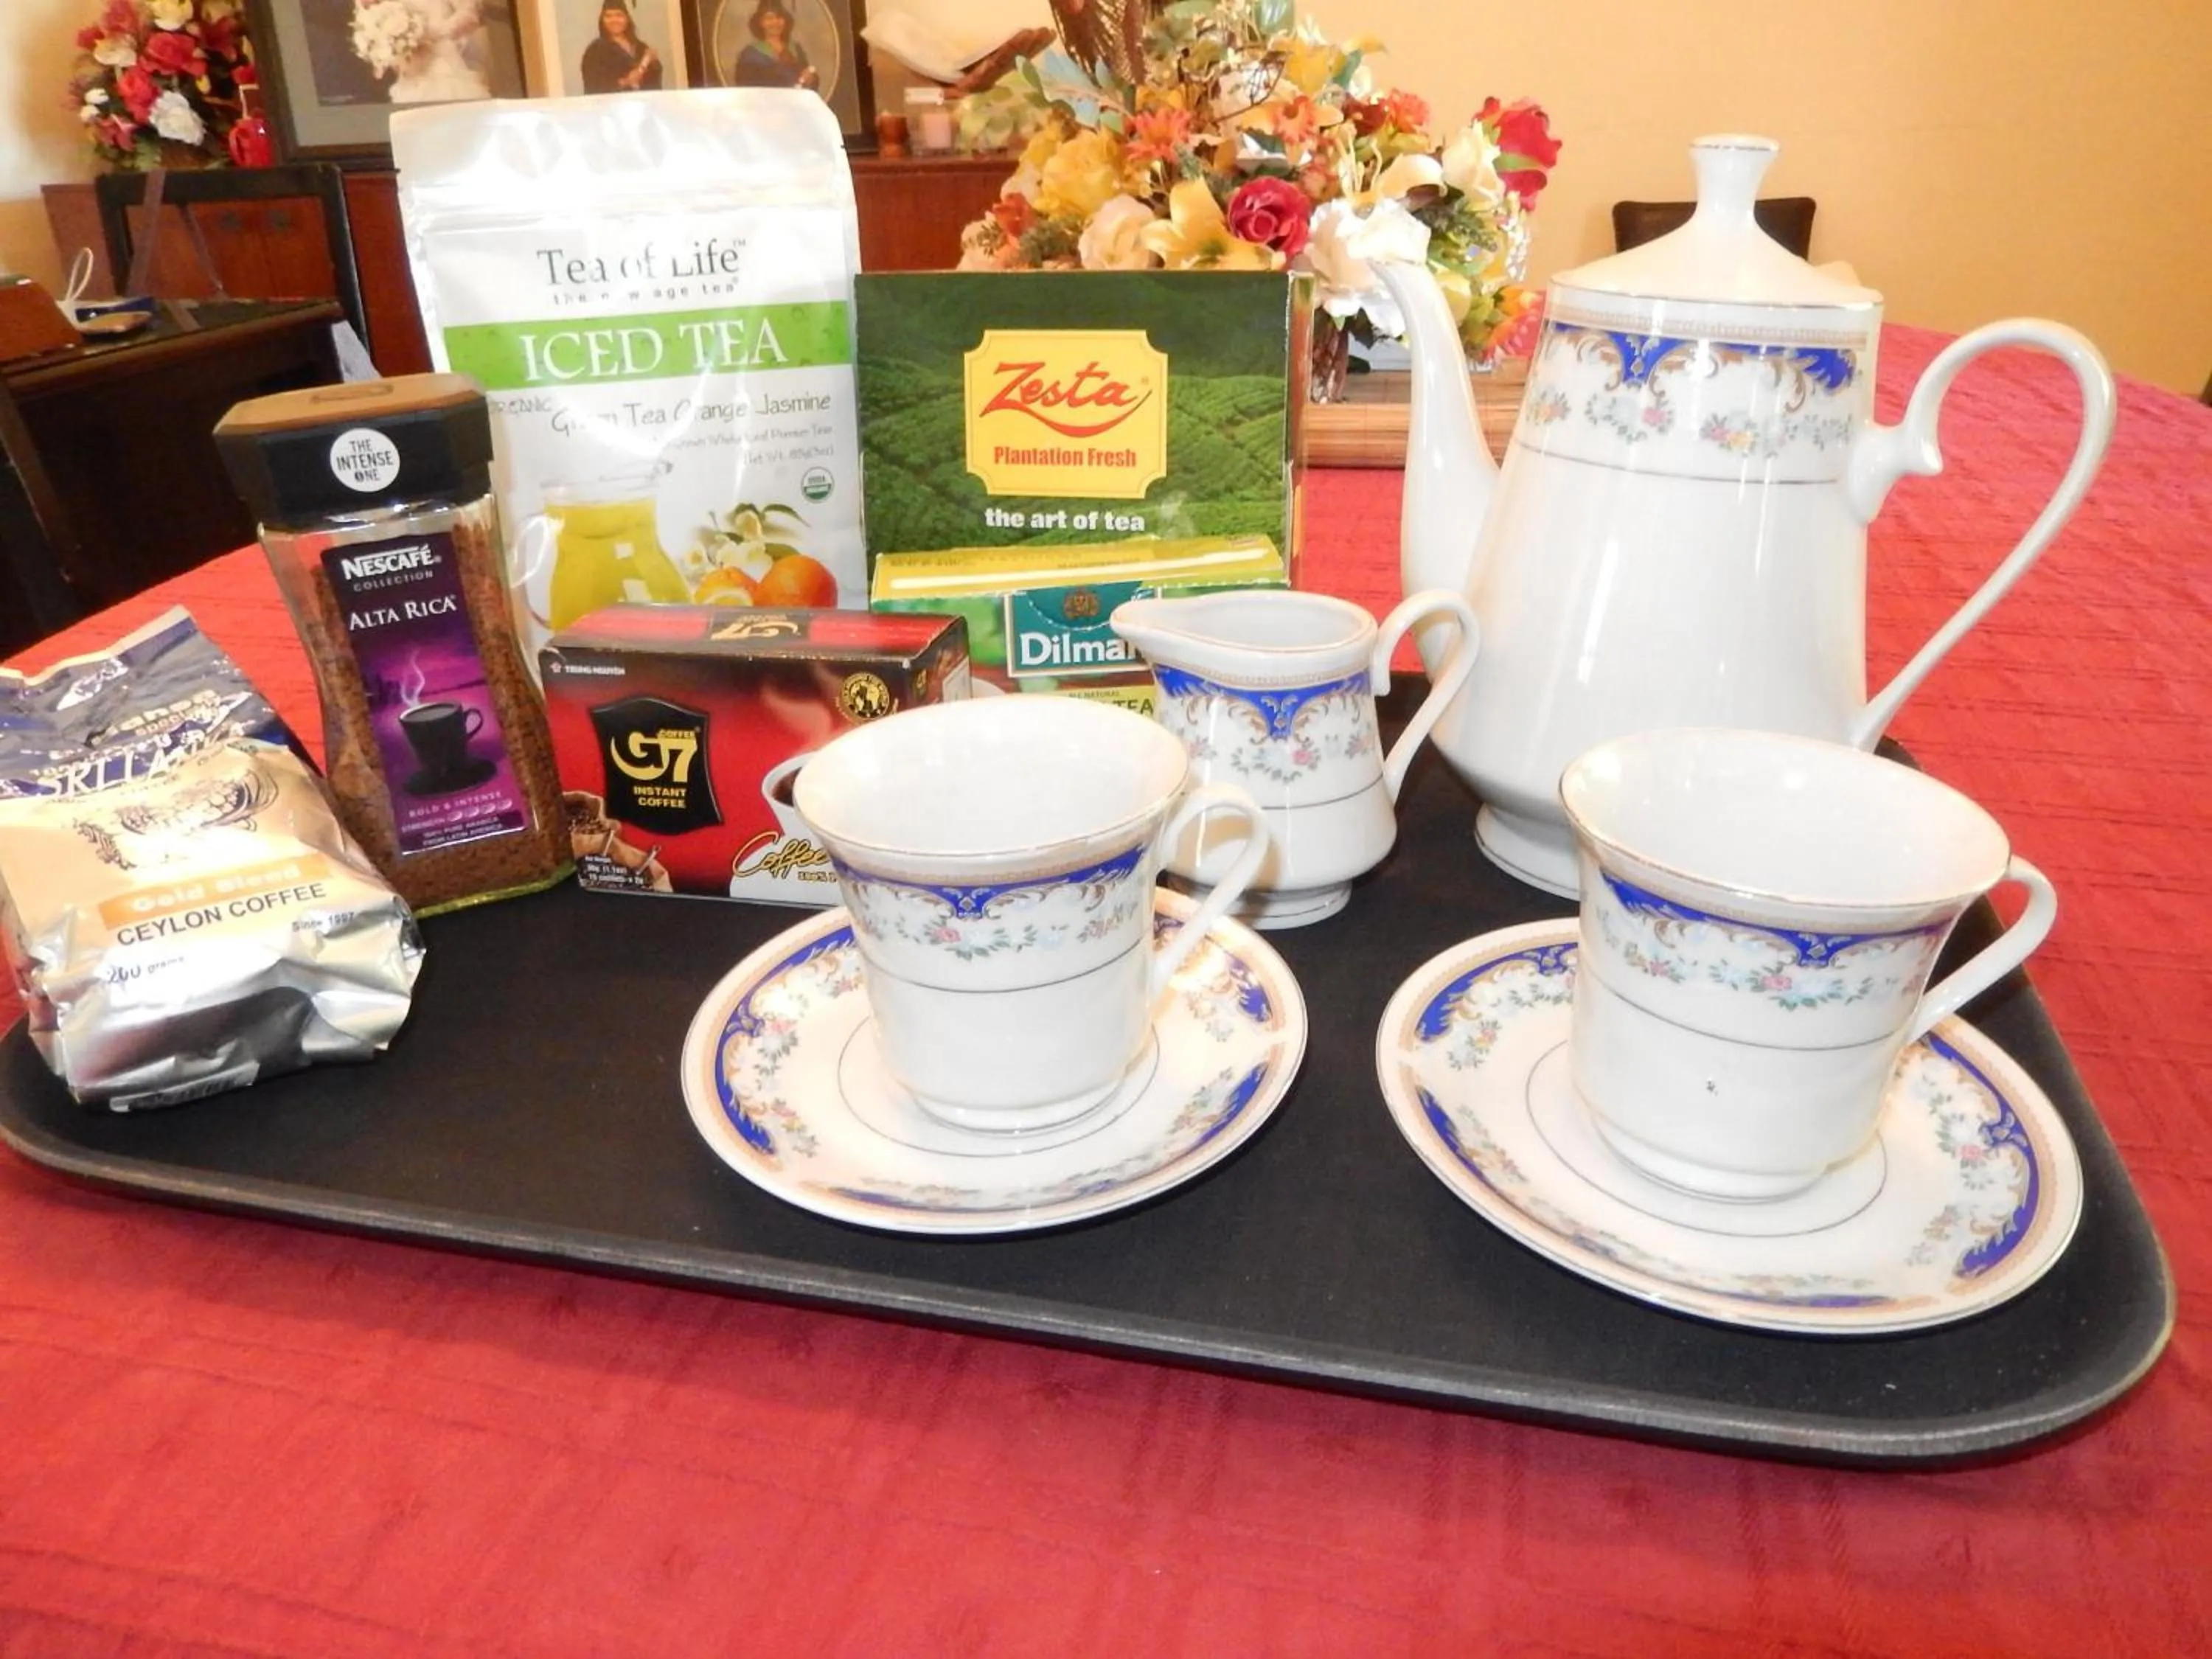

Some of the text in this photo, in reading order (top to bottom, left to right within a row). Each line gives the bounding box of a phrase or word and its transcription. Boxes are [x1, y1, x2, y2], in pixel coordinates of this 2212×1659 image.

[536, 238, 740, 285] Tea of Life
[653, 286, 689, 299] age
[702, 283, 734, 295] tea
[520, 318, 789, 381] ICED TEA
[623, 402, 666, 426] Tea
[673, 398, 748, 422] Oange
[755, 391, 832, 415] Jasmine
[979, 361, 1143, 426] Zesta
[336, 451, 394, 470] INTENSE
[348, 438, 372, 453] THE
[993, 445, 1137, 467] Plantation Fresh
[355, 468, 381, 482] ONE
[984, 507, 1145, 532] the art of tea
[341, 543, 434, 580] NESCAFÉ
[352, 570, 434, 592] COLLECTION
[349, 595, 457, 631] ALTA RICA
[656, 728, 695, 739] COFFEE
[611, 731, 698, 782] G7
[633, 785, 687, 797] INSTANT
[637, 796, 686, 810] COFFEE
[732, 831, 830, 879] Coffee
[131, 865, 301, 912] Gold Blend
[117, 883, 327, 946] CEYLON COFFEE
